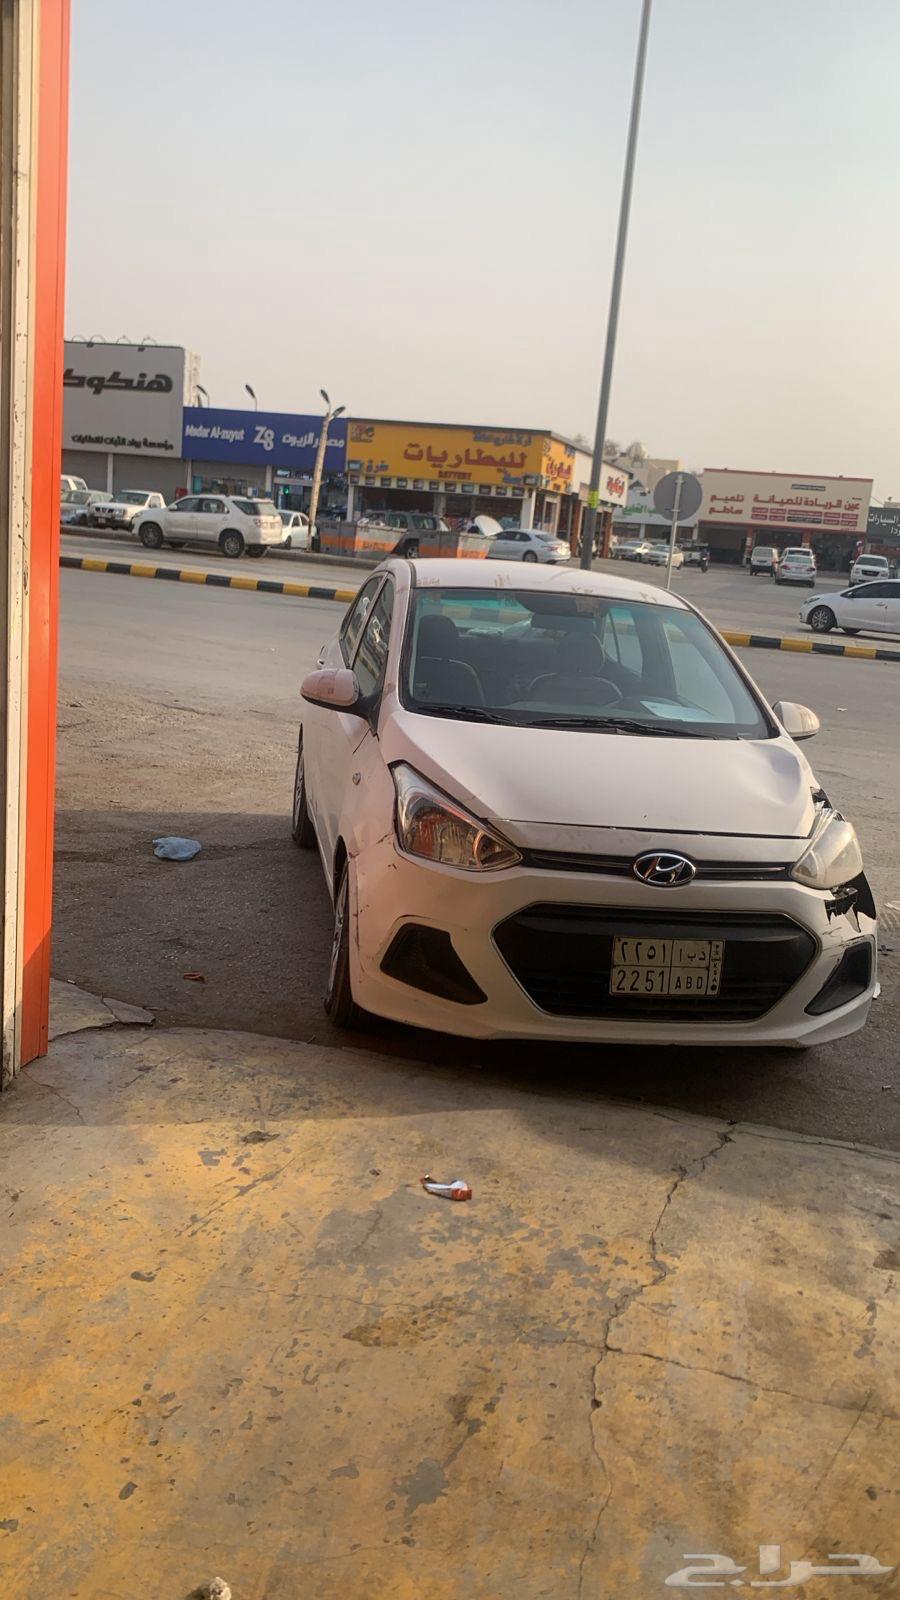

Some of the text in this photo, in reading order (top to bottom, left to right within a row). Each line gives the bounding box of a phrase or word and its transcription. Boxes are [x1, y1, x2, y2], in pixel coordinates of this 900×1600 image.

[282, 432, 345, 448] مصر الزيوت
[403, 443, 528, 469] للبطاريات
[710, 494, 744, 502] تلميع
[753, 494, 803, 506] للصيانة
[709, 505, 743, 515] ساطع
[844, 500, 860, 511] عين
[621, 941, 666, 964] ٢٢٥١
[616, 969, 665, 992] 2251
